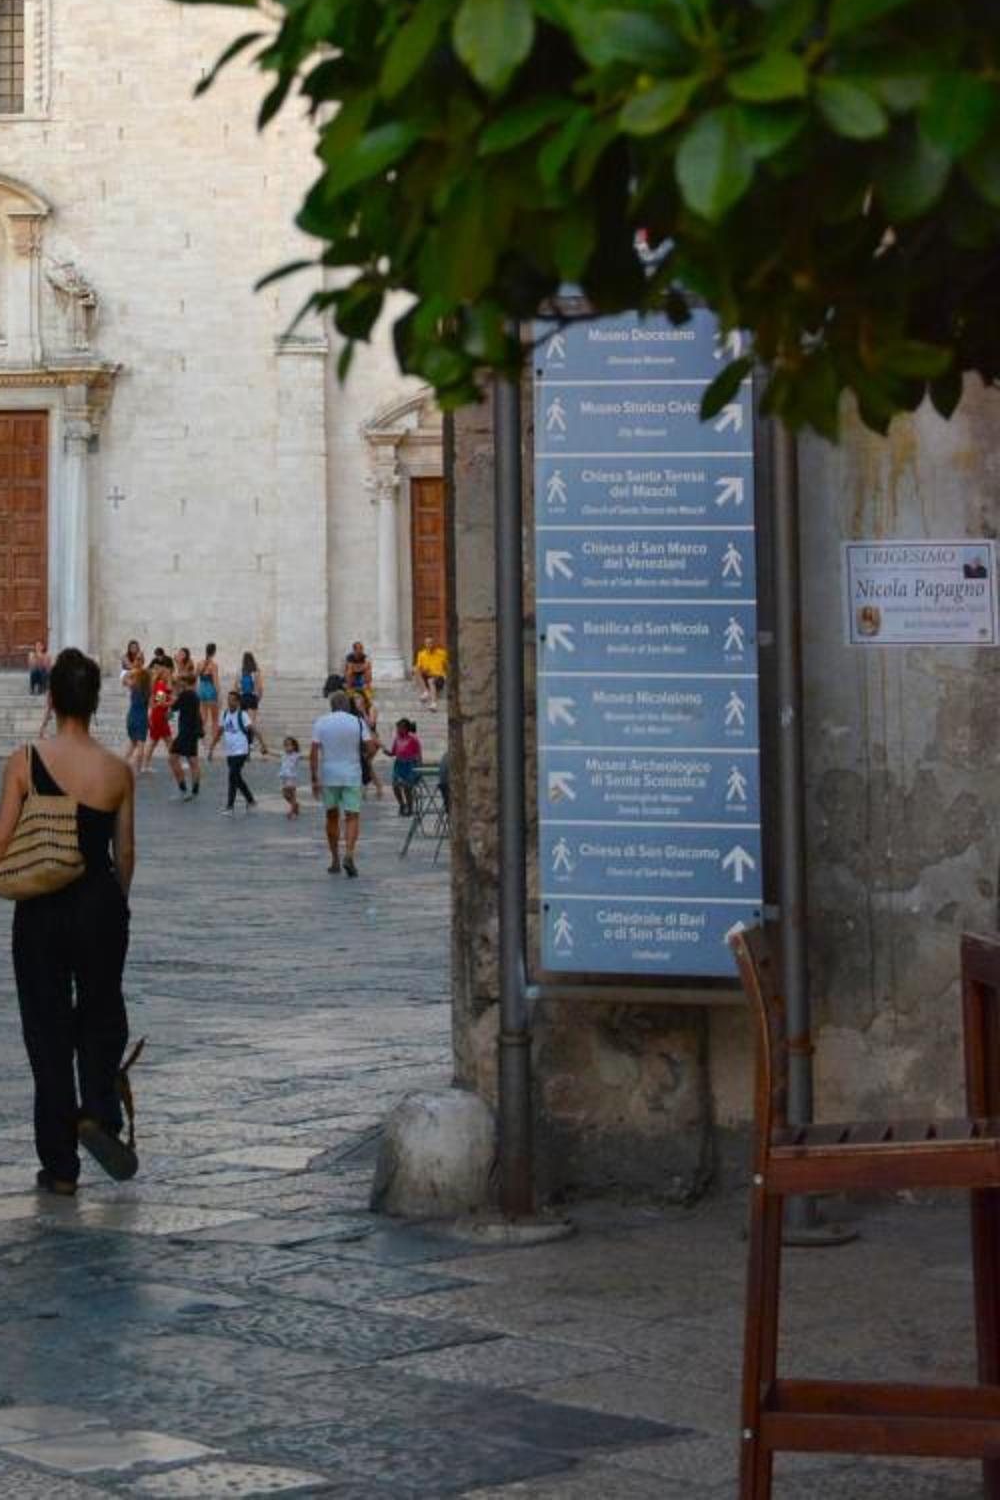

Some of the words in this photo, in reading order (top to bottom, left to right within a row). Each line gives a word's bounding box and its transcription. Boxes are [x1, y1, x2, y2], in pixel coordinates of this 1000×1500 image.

[588, 328, 629, 342] Museo
[632, 328, 695, 342] Diocesano
[581, 402, 621, 415] Museo
[623, 402, 665, 415] Storico
[668, 402, 700, 415] Civic
[581, 470, 623, 483] Chiesa
[626, 470, 662, 483] Santa
[663, 470, 706, 483] Teresa
[609, 485, 628, 498] dei
[632, 485, 677, 498] Maschi
[582, 542, 623, 555] Chiesa
[628, 542, 640, 555] di
[643, 542, 665, 555] San
[668, 542, 708, 556] Marco
[604, 557, 623, 570] dei
[627, 557, 687, 570] Veneziani
[864, 548, 956, 565] TRIGESIMO
[856, 578, 908, 598] Nicola
[914, 579, 986, 604] Papagno
[583, 620, 629, 635] Basilica
[631, 621, 643, 635] di
[645, 621, 669, 635] San
[671, 621, 709, 636] Nicola
[592, 691, 633, 705] Museo
[586, 758, 628, 772] Museo
[630, 759, 712, 776] Archeologico
[591, 774, 603, 787] di
[606, 774, 641, 787] Santa
[579, 843, 621, 857] Chiesa
[624, 844, 635, 858] di
[638, 845, 662, 858] San
[665, 846, 720, 860] Giacomo
[596, 910, 662, 925] Cattedrale
[665, 913, 677, 925] di
[679, 913, 705, 926] Bari
[615, 927, 627, 940] di
[629, 928, 653, 941] San
[654, 928, 700, 943] Sabino
